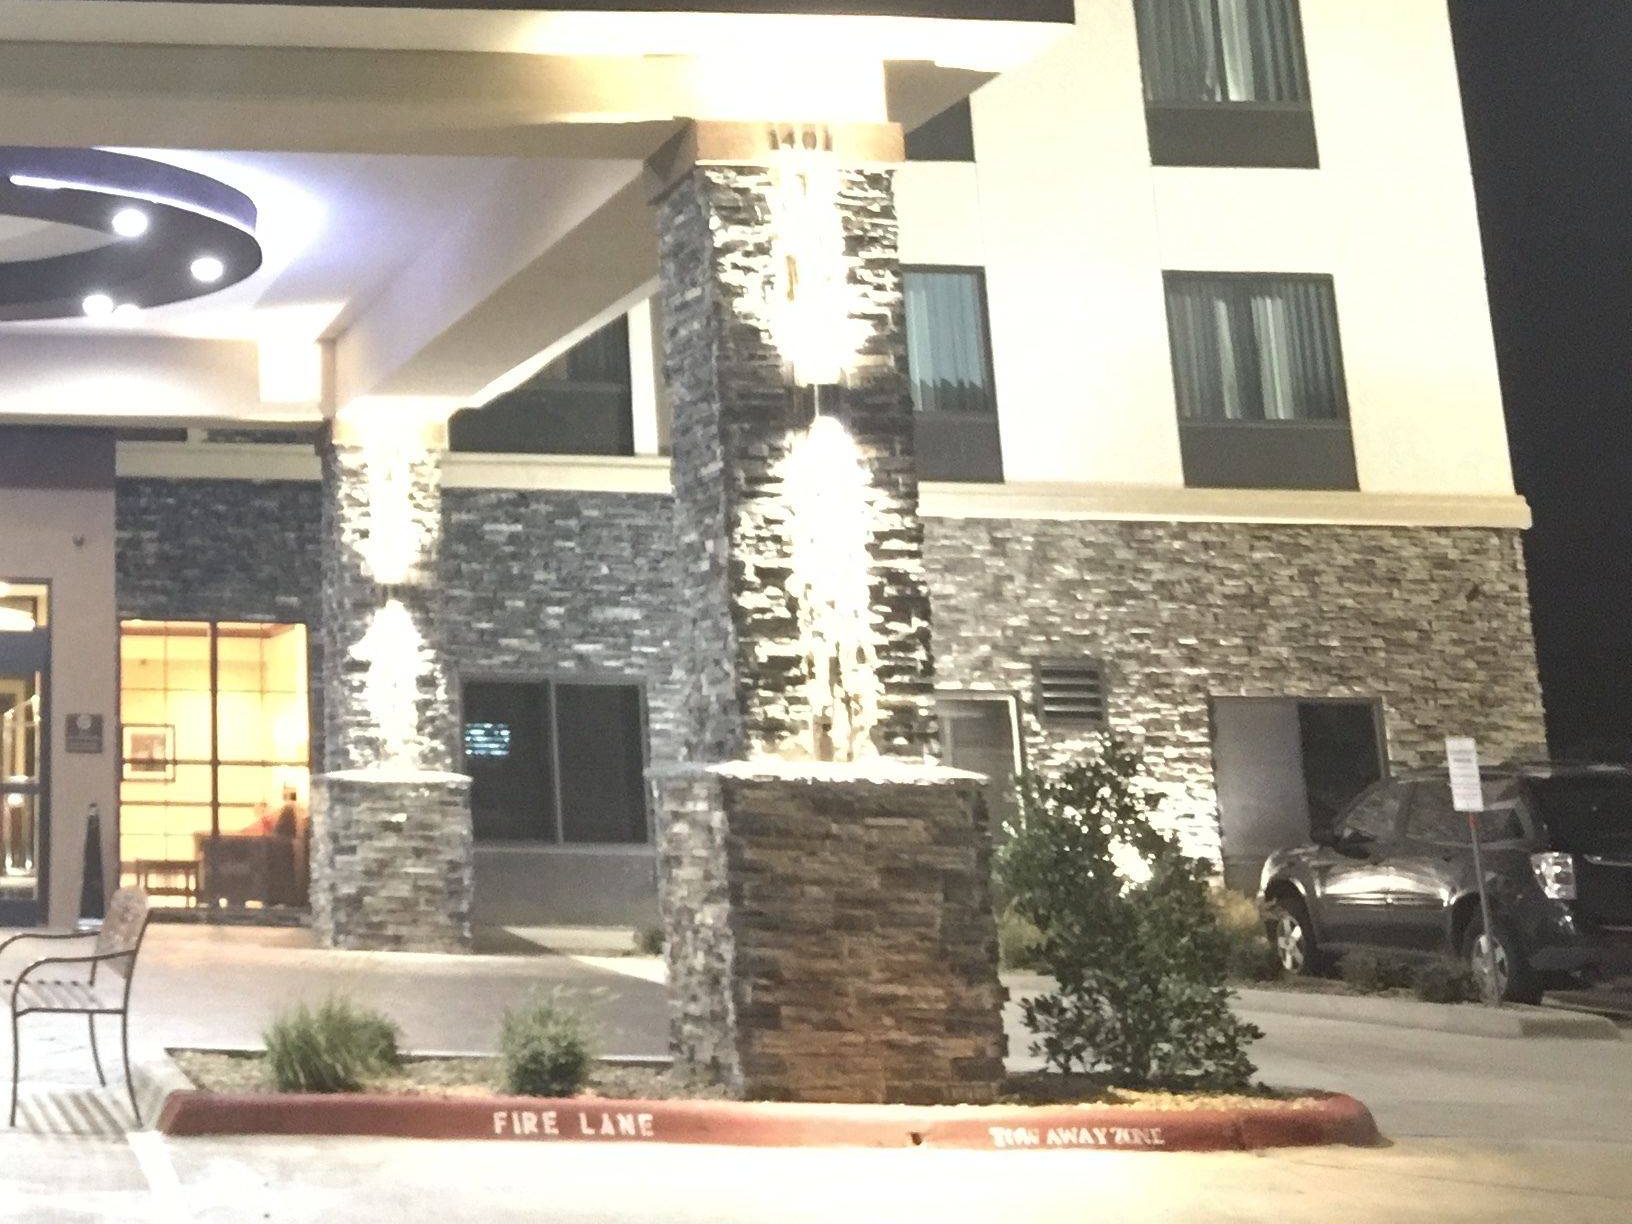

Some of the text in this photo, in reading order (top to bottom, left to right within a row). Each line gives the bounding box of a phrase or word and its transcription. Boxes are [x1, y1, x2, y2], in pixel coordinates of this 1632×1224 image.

[493, 1111, 655, 1137] FIRE LANE
[1046, 1127, 1108, 1145] AWAY
